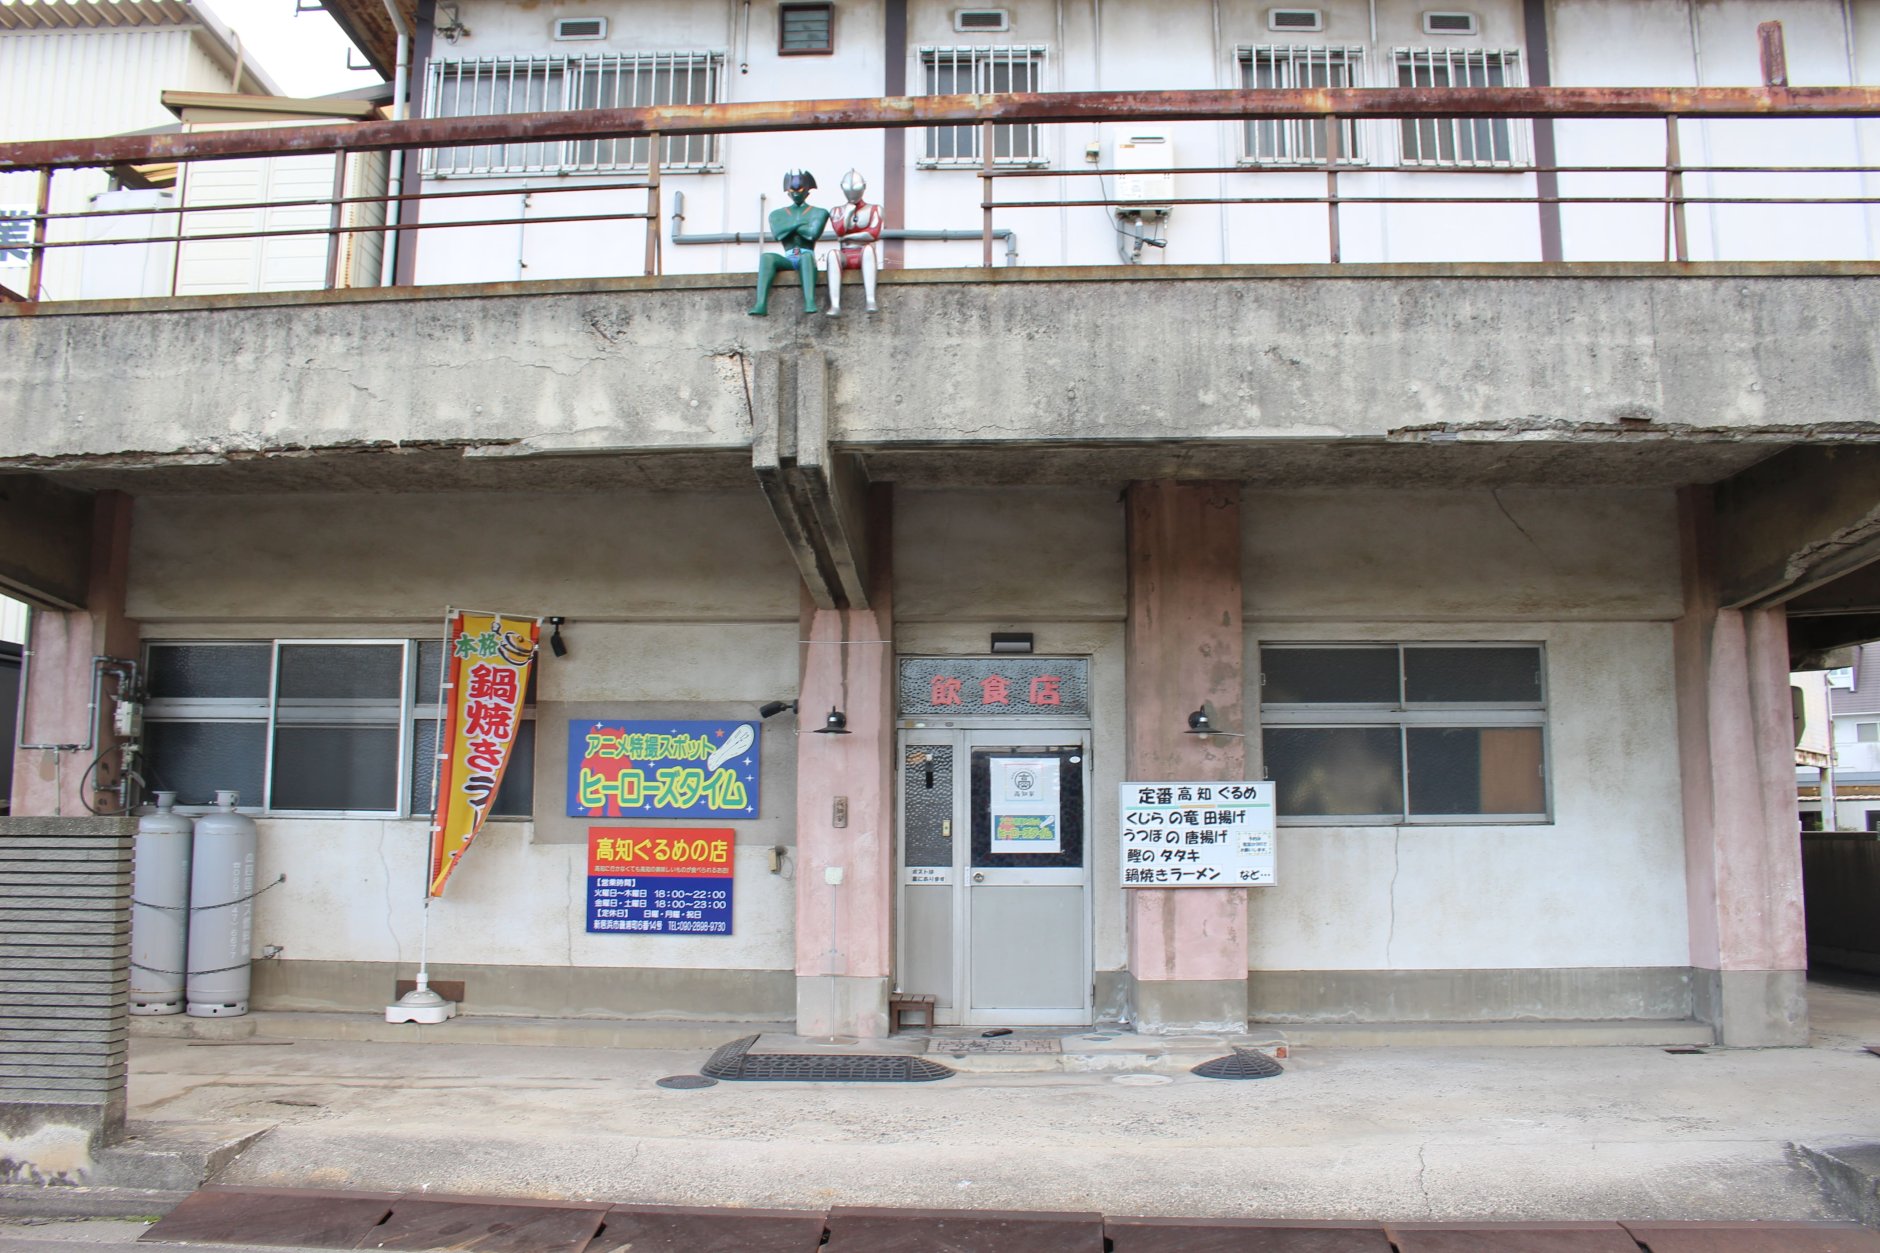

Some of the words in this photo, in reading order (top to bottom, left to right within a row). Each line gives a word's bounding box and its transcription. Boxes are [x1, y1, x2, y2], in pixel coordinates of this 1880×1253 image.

[455, 632, 501, 658] 本格
[930, 674, 1062, 706] 飲食店
[586, 734, 716, 760] アニメ特撮スポット
[581, 767, 748, 809] ヒーローズタイム
[1126, 810, 1246, 825] くじらの竜田揚げ
[596, 837, 728, 862] 高知ぐるめの店
[1127, 848, 1200, 863] 鰹のタタキ
[597, 878, 636, 887] 【営業時間】
[1125, 867, 1221, 883] 鍋焼きラーメン
